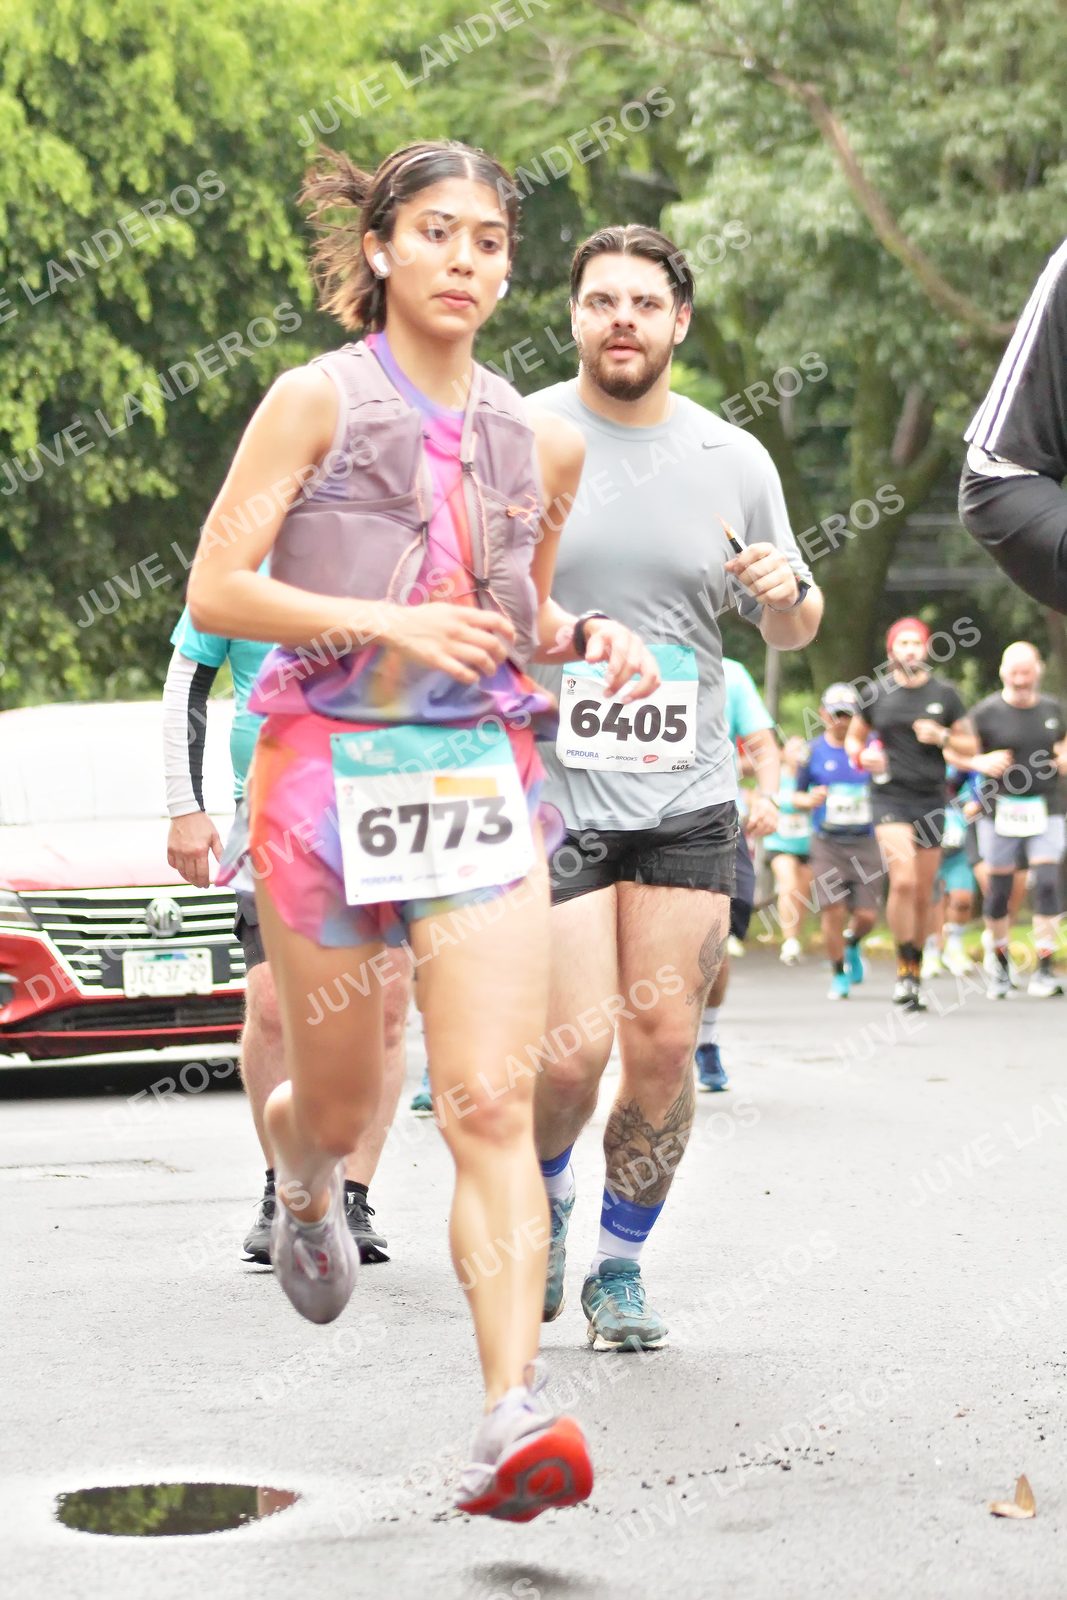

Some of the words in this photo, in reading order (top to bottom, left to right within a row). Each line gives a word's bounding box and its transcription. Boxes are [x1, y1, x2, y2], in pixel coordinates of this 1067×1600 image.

[570, 699, 688, 743] 6405
[566, 749, 599, 758] PERDURA
[357, 795, 513, 857] 6773
